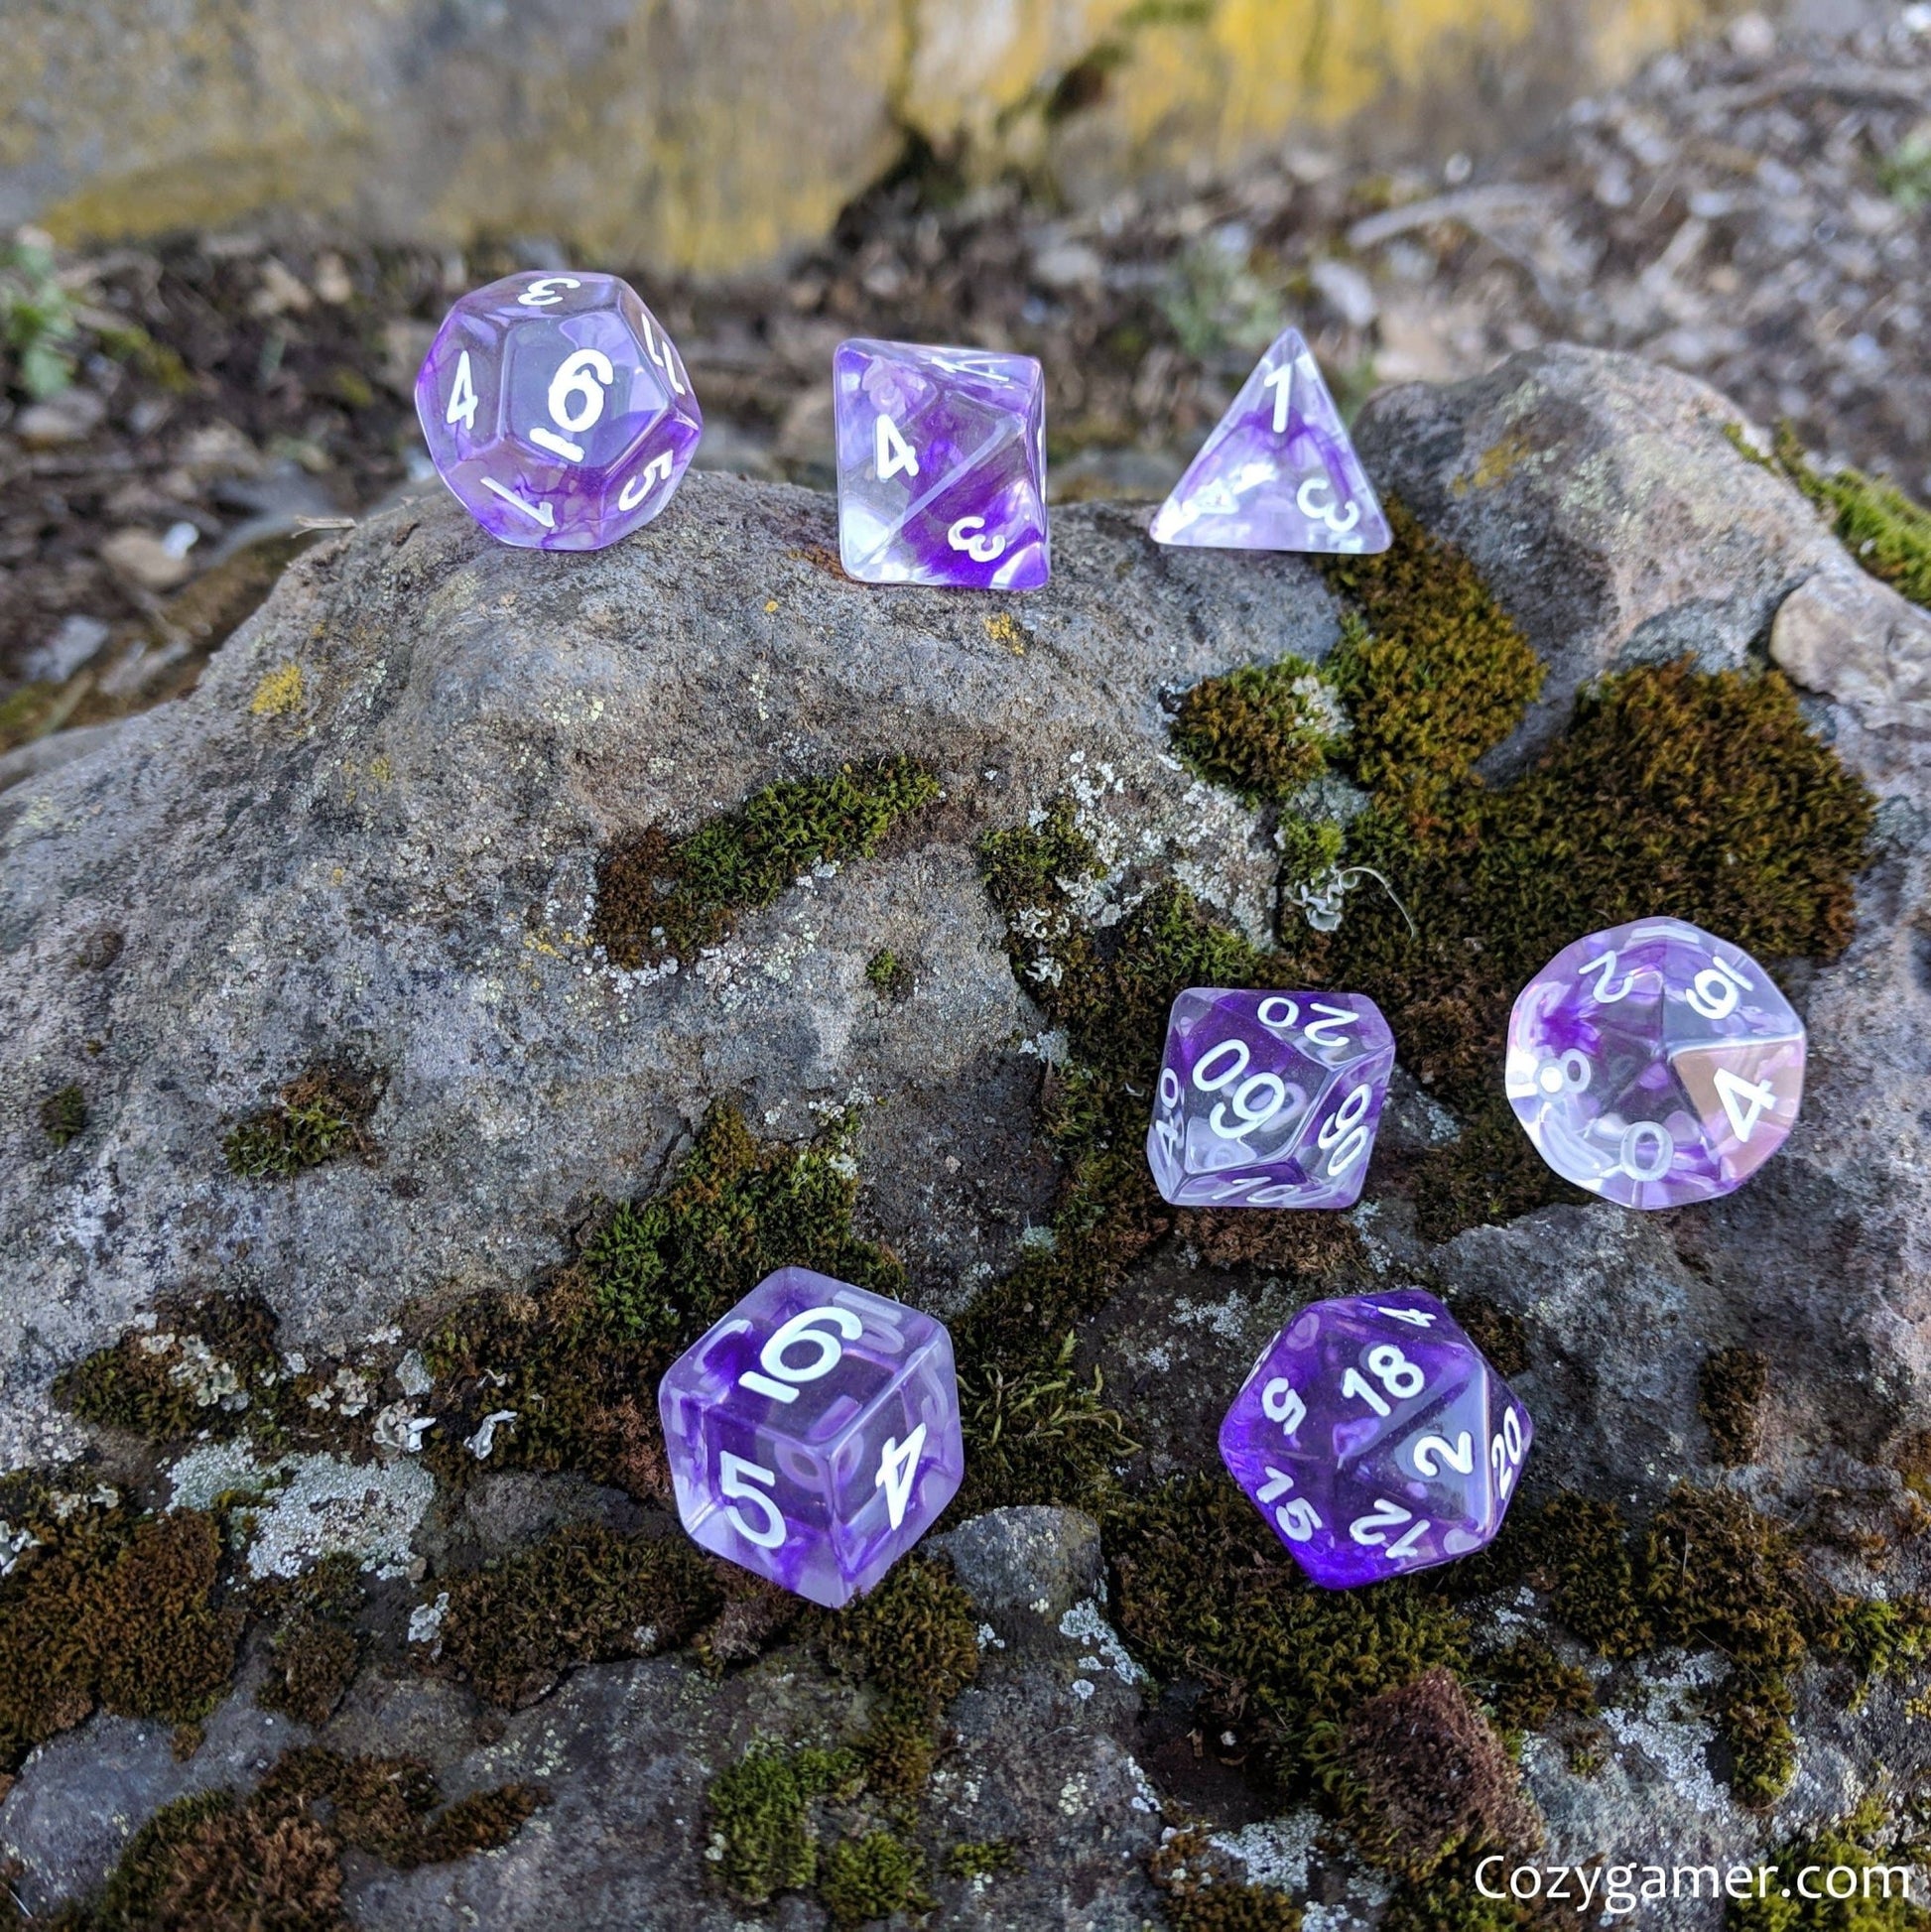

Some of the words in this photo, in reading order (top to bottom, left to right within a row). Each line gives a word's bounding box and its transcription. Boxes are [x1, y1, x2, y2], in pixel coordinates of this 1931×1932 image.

[518, 278, 581, 306] 3
[447, 350, 478, 430] 4
[530, 348, 614, 462] 6
[1263, 363, 1292, 434] 1
[618, 450, 673, 512] 5
[875, 414, 919, 482] 4
[948, 516, 1006, 563] 3
[1297, 478, 1359, 532] 3
[1579, 951, 1633, 1004] 2
[1714, 1068, 1778, 1143] 4
[1620, 1121, 1674, 1181] 0
[1377, 1307, 1437, 1328] 4
[738, 1306, 863, 1404] 6
[1343, 1346, 1425, 1416] 18
[1261, 1377, 1307, 1436] 5
[875, 1423, 927, 1530] 4
[1413, 1431, 1474, 1478] 2
[1491, 1405, 1521, 1499] 20
[719, 1451, 786, 1549] 5
[1256, 1467, 1323, 1542] 15
